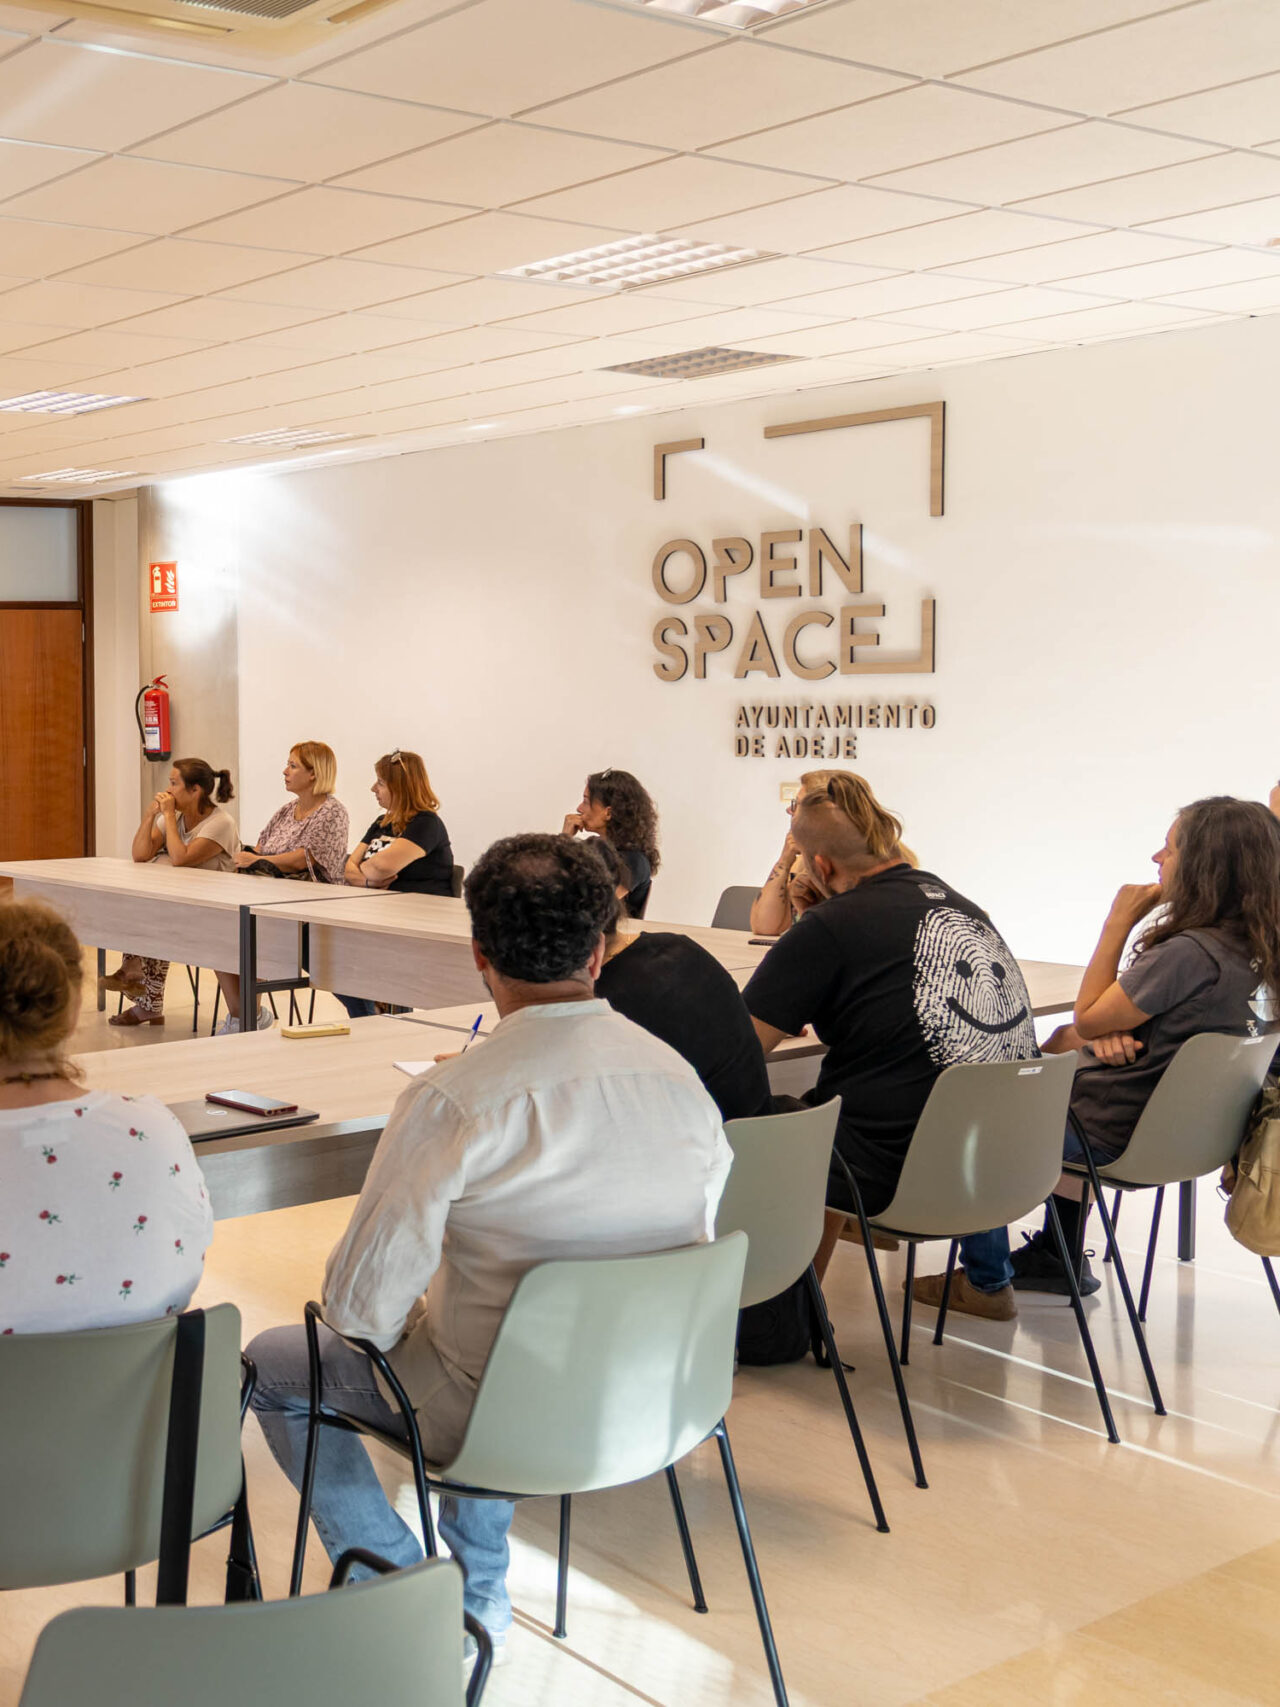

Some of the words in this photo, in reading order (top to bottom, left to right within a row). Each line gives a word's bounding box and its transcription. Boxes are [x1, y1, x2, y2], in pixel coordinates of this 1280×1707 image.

[652, 524, 863, 605] OPEN
[653, 604, 936, 682] SPACE
[735, 704, 936, 729] AYUNTAMIENTO
[735, 735, 765, 758] DE
[775, 736, 857, 759] ADEJE
